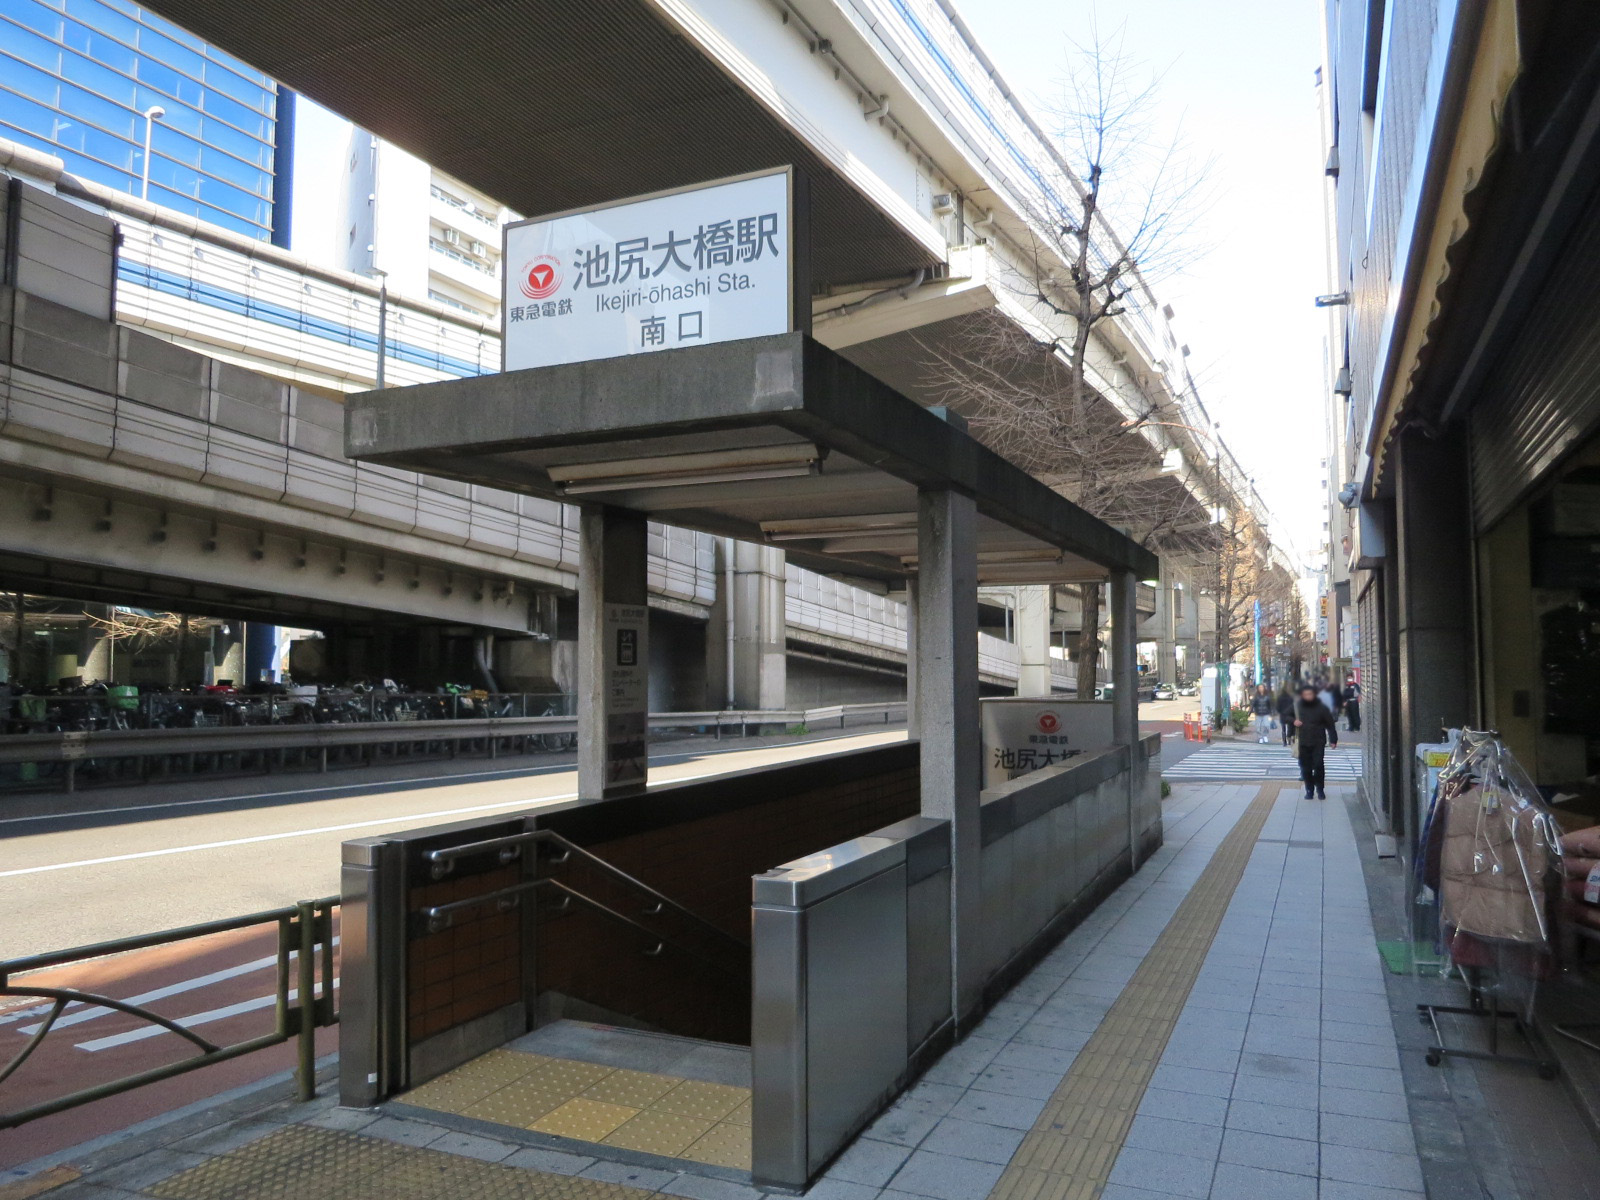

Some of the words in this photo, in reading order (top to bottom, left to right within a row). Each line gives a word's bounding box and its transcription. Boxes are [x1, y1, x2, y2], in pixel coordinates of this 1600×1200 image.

[573, 212, 780, 292] 池尻大橋駅
[509, 298, 574, 323] 東急電鉄
[596, 276, 711, 314] Ikejiri-ōhashi
[717, 272, 756, 293] Sta.
[639, 310, 704, 348] 南口
[1028, 734, 1069, 745] 東急電鉄
